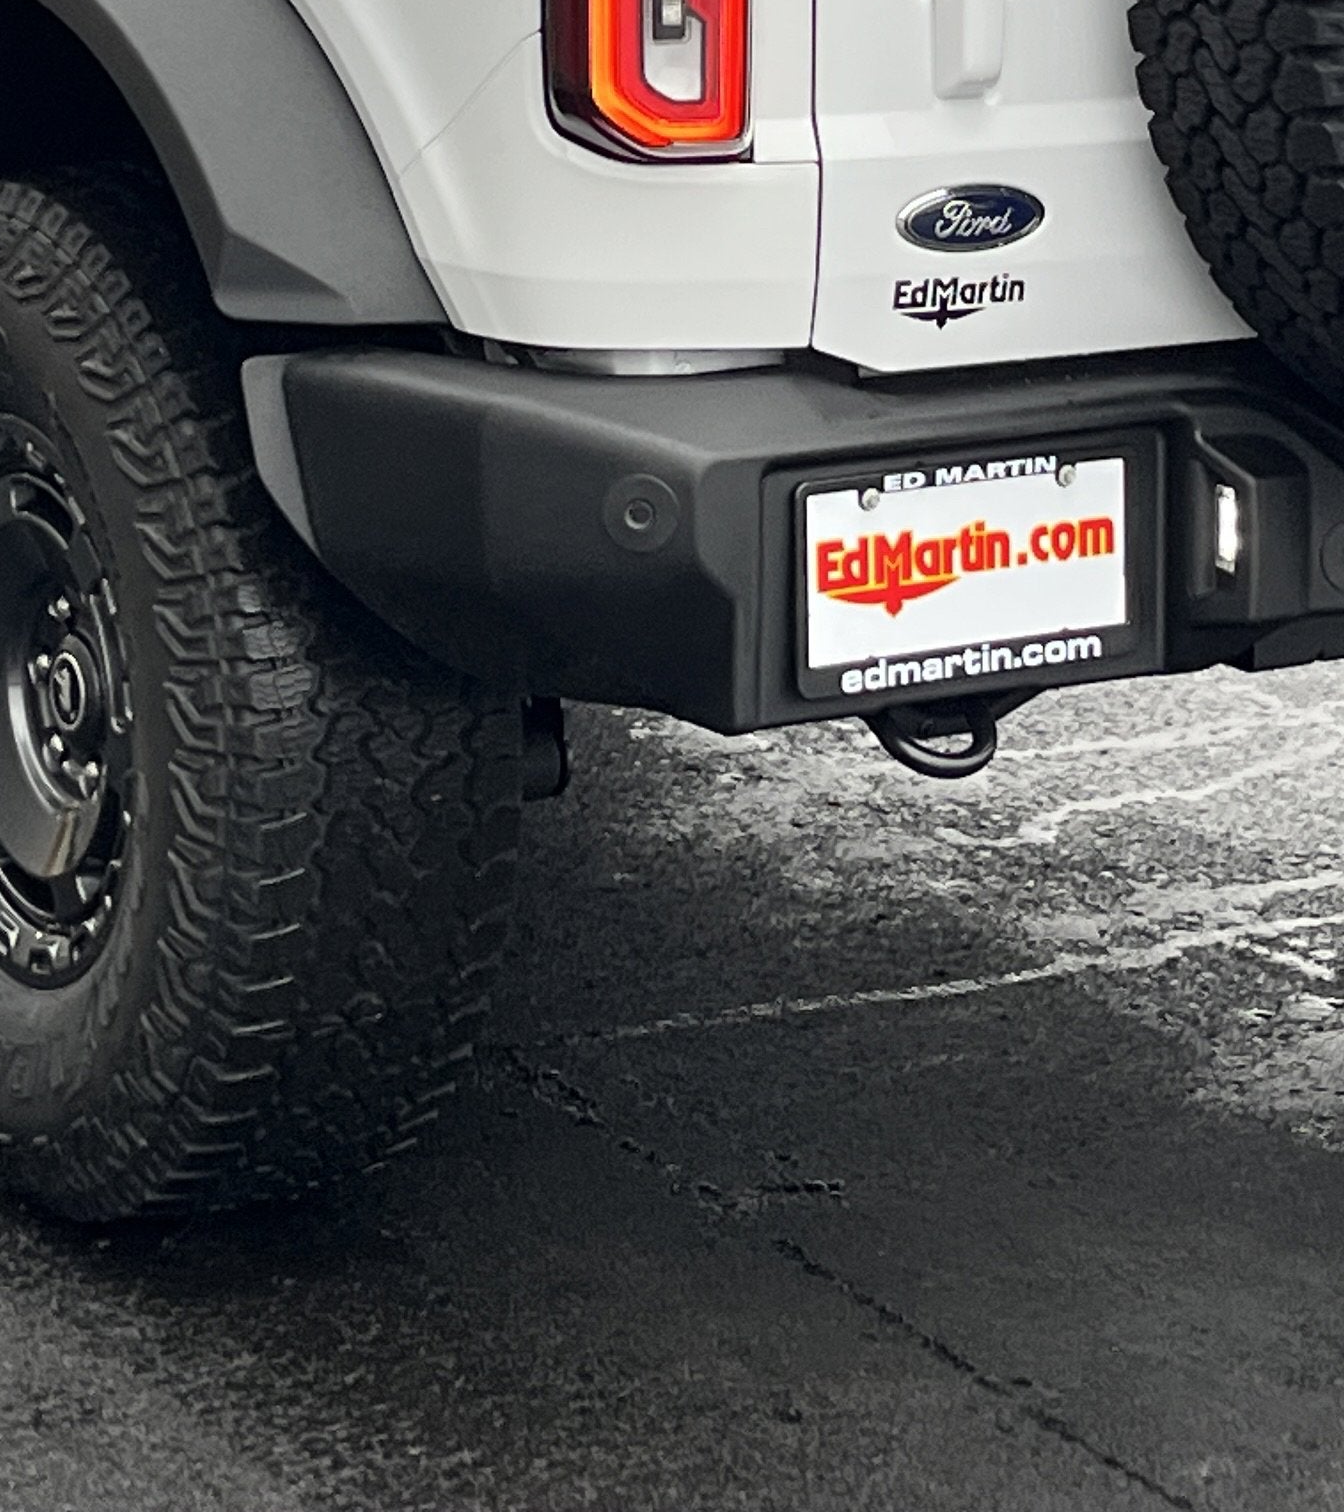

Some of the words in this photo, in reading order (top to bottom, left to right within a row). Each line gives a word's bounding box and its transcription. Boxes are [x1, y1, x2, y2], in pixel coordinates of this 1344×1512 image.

[934, 199, 1015, 239] Ford
[883, 471, 926, 493] ED
[934, 455, 1057, 487] MARTIN
[840, 634, 1103, 695] edmartin.com
